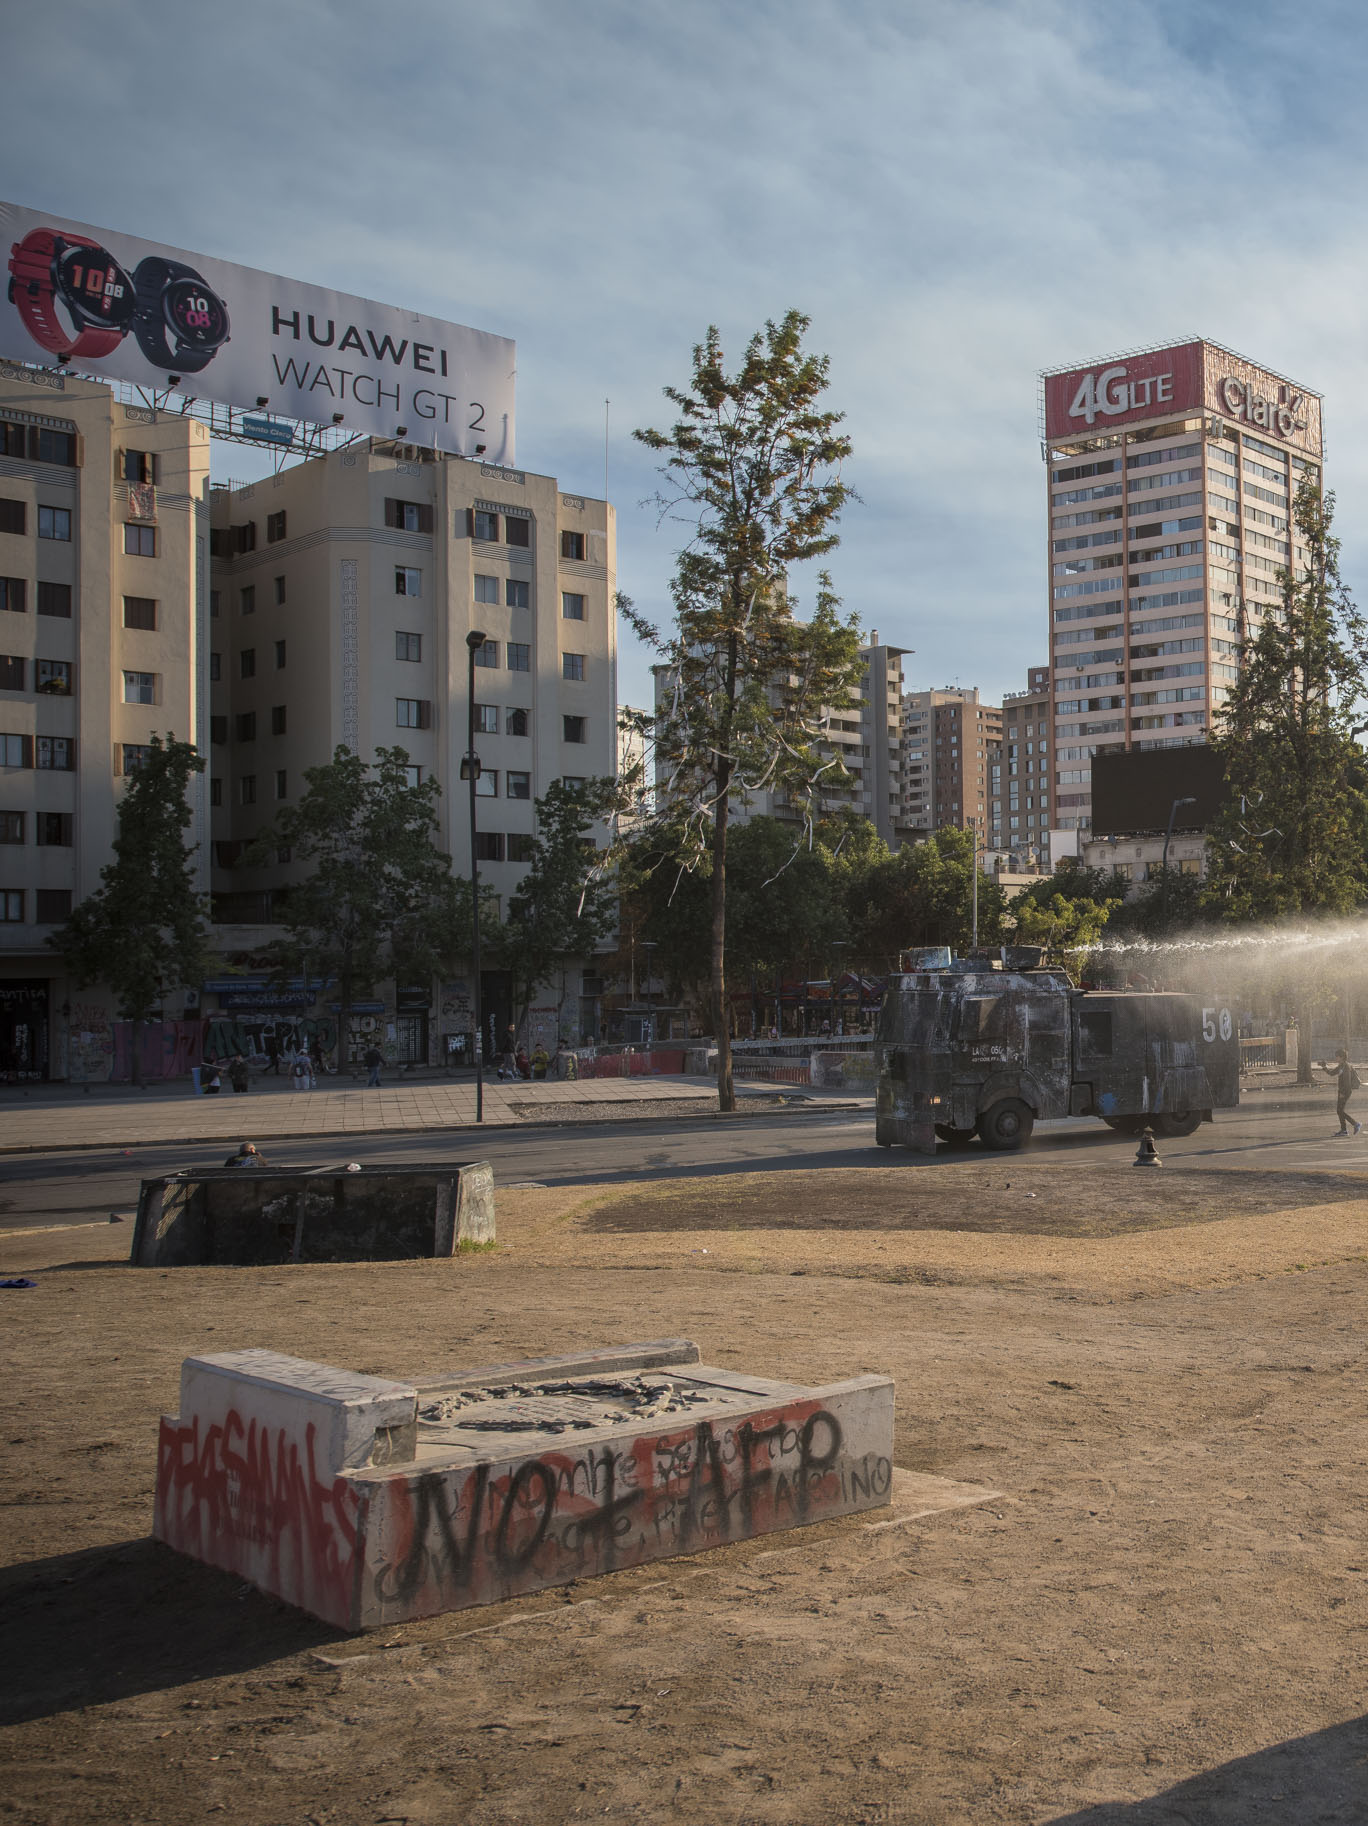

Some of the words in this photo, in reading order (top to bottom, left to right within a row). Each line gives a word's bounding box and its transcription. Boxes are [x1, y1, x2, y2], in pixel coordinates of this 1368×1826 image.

[72, 264, 105, 293] 10
[185, 311, 211, 329] 08
[186, 297, 209, 313] 10
[272, 306, 449, 377] HUAWEI
[272, 353, 401, 403] WATCH
[412, 389, 458, 424] GT
[467, 402, 487, 433] 2
[1221, 376, 1296, 437] Claro
[1202, 1007, 1233, 1043] 50
